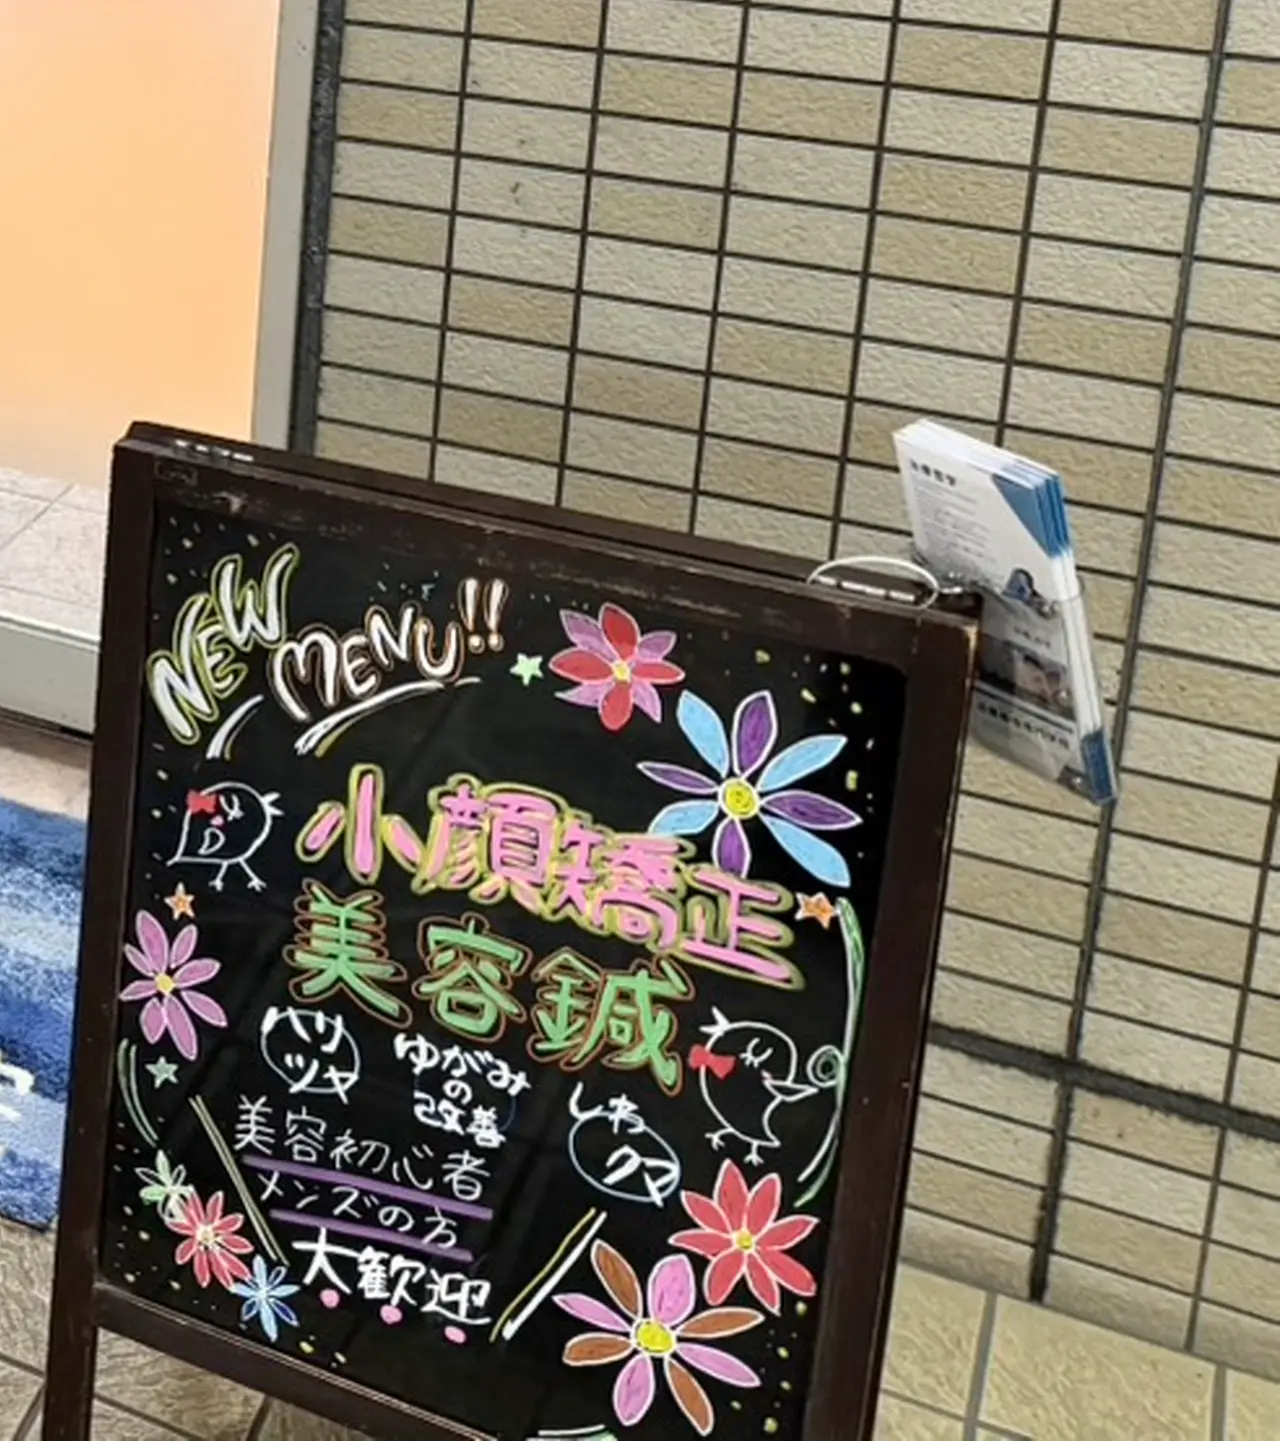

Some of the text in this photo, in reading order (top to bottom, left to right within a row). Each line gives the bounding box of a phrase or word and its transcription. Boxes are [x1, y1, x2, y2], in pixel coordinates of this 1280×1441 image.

[146, 543, 300, 744] NEW
[271, 577, 510, 722] MENU!!
[295, 763, 808, 991] 小顔矯正
[261, 1005, 343, 1053] ハリ
[282, 881, 699, 1095] 美容鍼
[284, 1052, 359, 1105] ツヤ
[393, 1032, 532, 1096] ゆがみ
[235, 1094, 493, 1203] 美容初心者
[412, 1090, 507, 1149] 改善
[256, 1169, 459, 1250] メンズの方
[601, 1145, 680, 1209] クマ
[291, 1226, 493, 1327] 大歓迎
